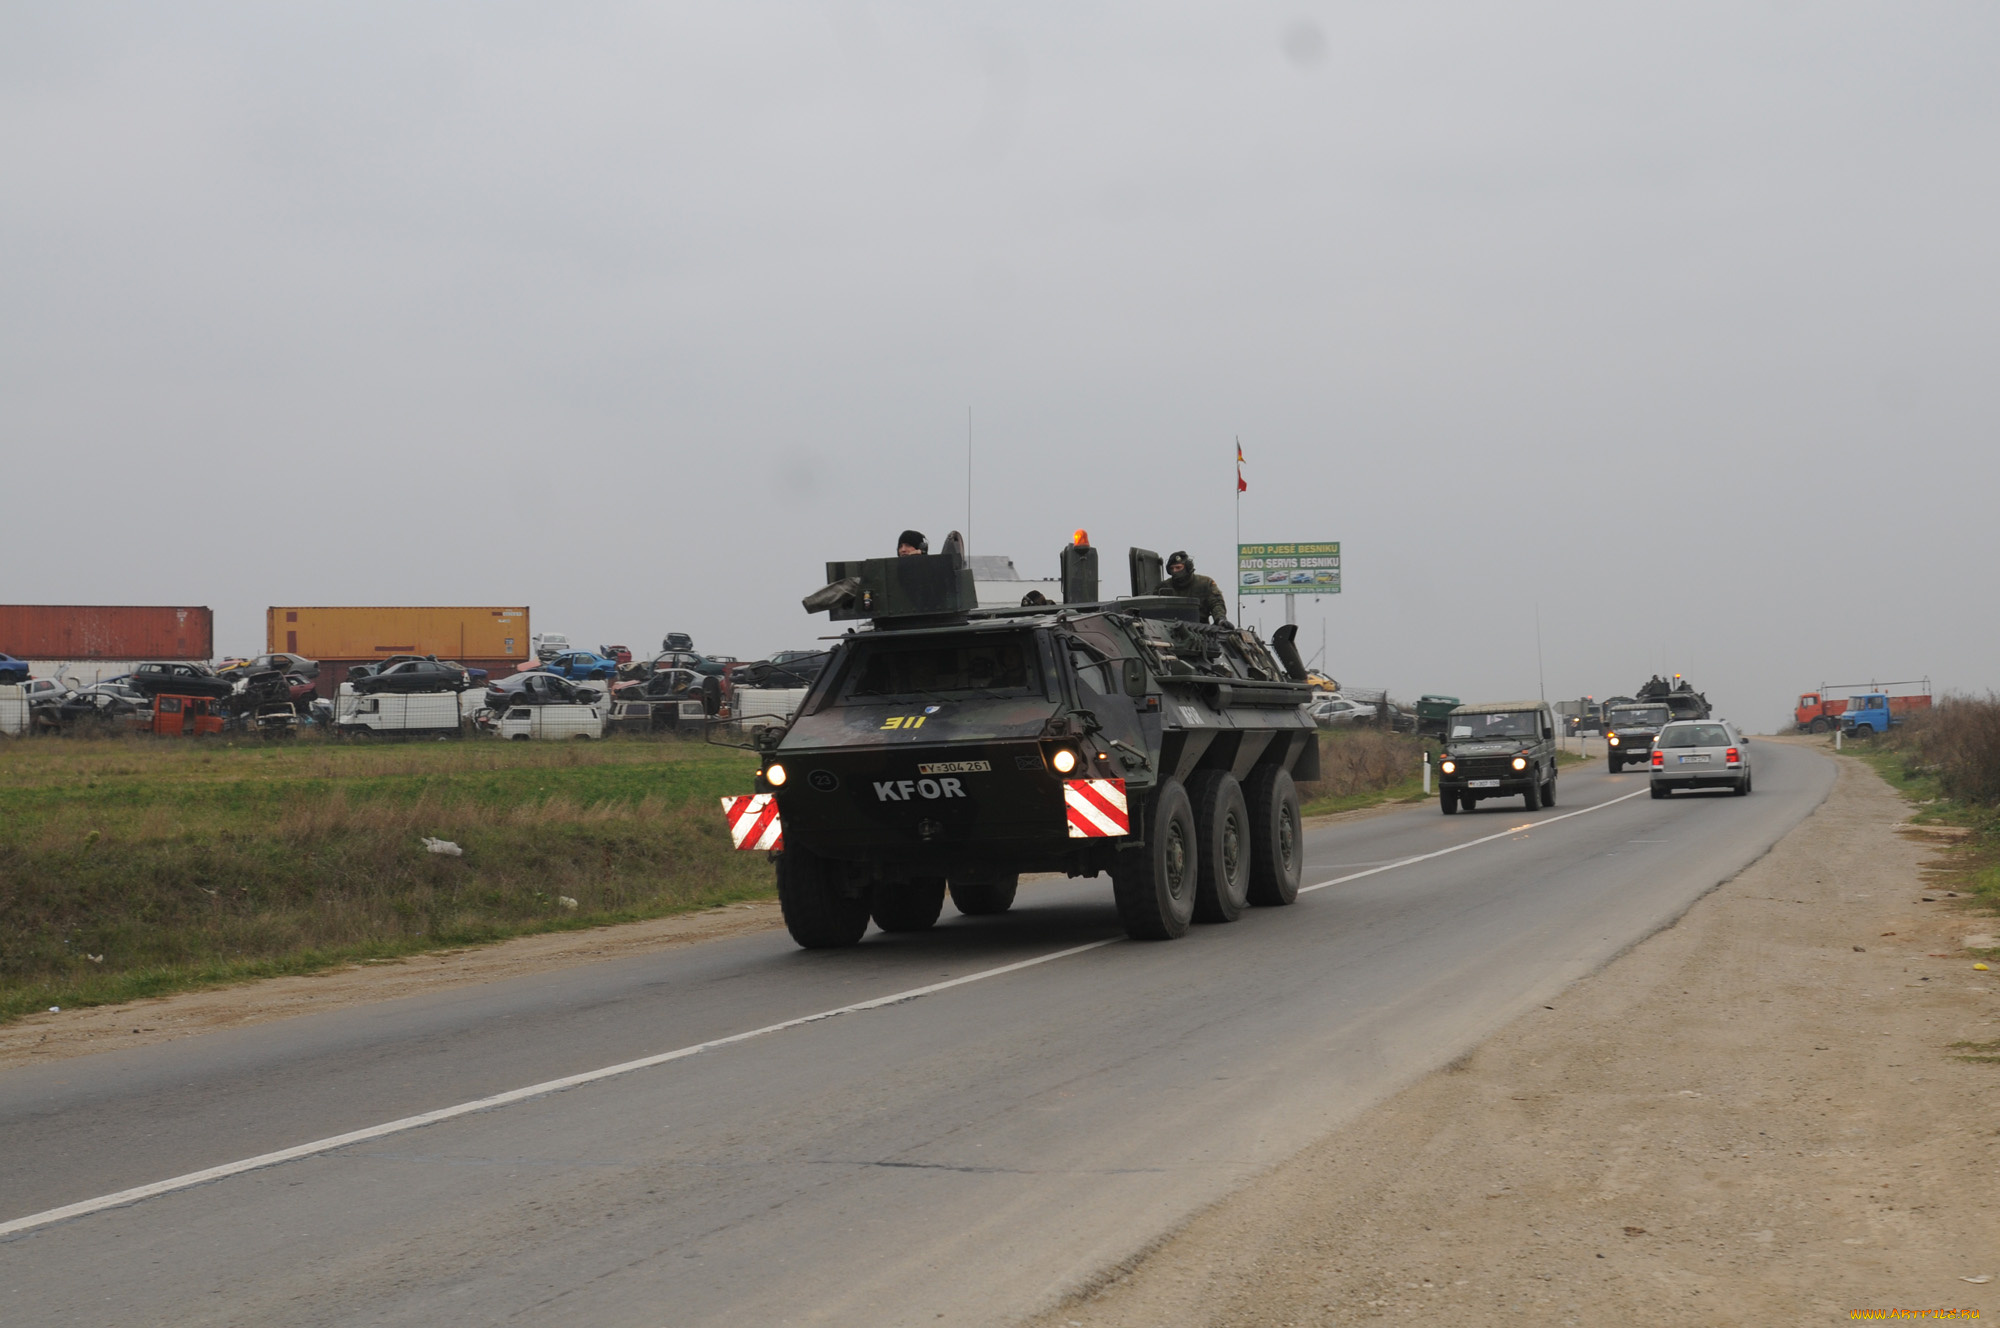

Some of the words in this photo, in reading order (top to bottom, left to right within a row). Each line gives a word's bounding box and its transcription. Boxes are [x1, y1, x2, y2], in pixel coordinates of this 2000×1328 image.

[1241, 546, 1265, 554] AUTO
[1298, 544, 1338, 553] BESNIKU
[1240, 558, 1264, 569] AUTO
[1265, 558, 1298, 568] SERVIS
[1300, 557, 1339, 567] BESNIKU
[880, 716, 926, 730] 311
[966, 761, 989, 771] 261
[872, 777, 966, 802] KFOR
